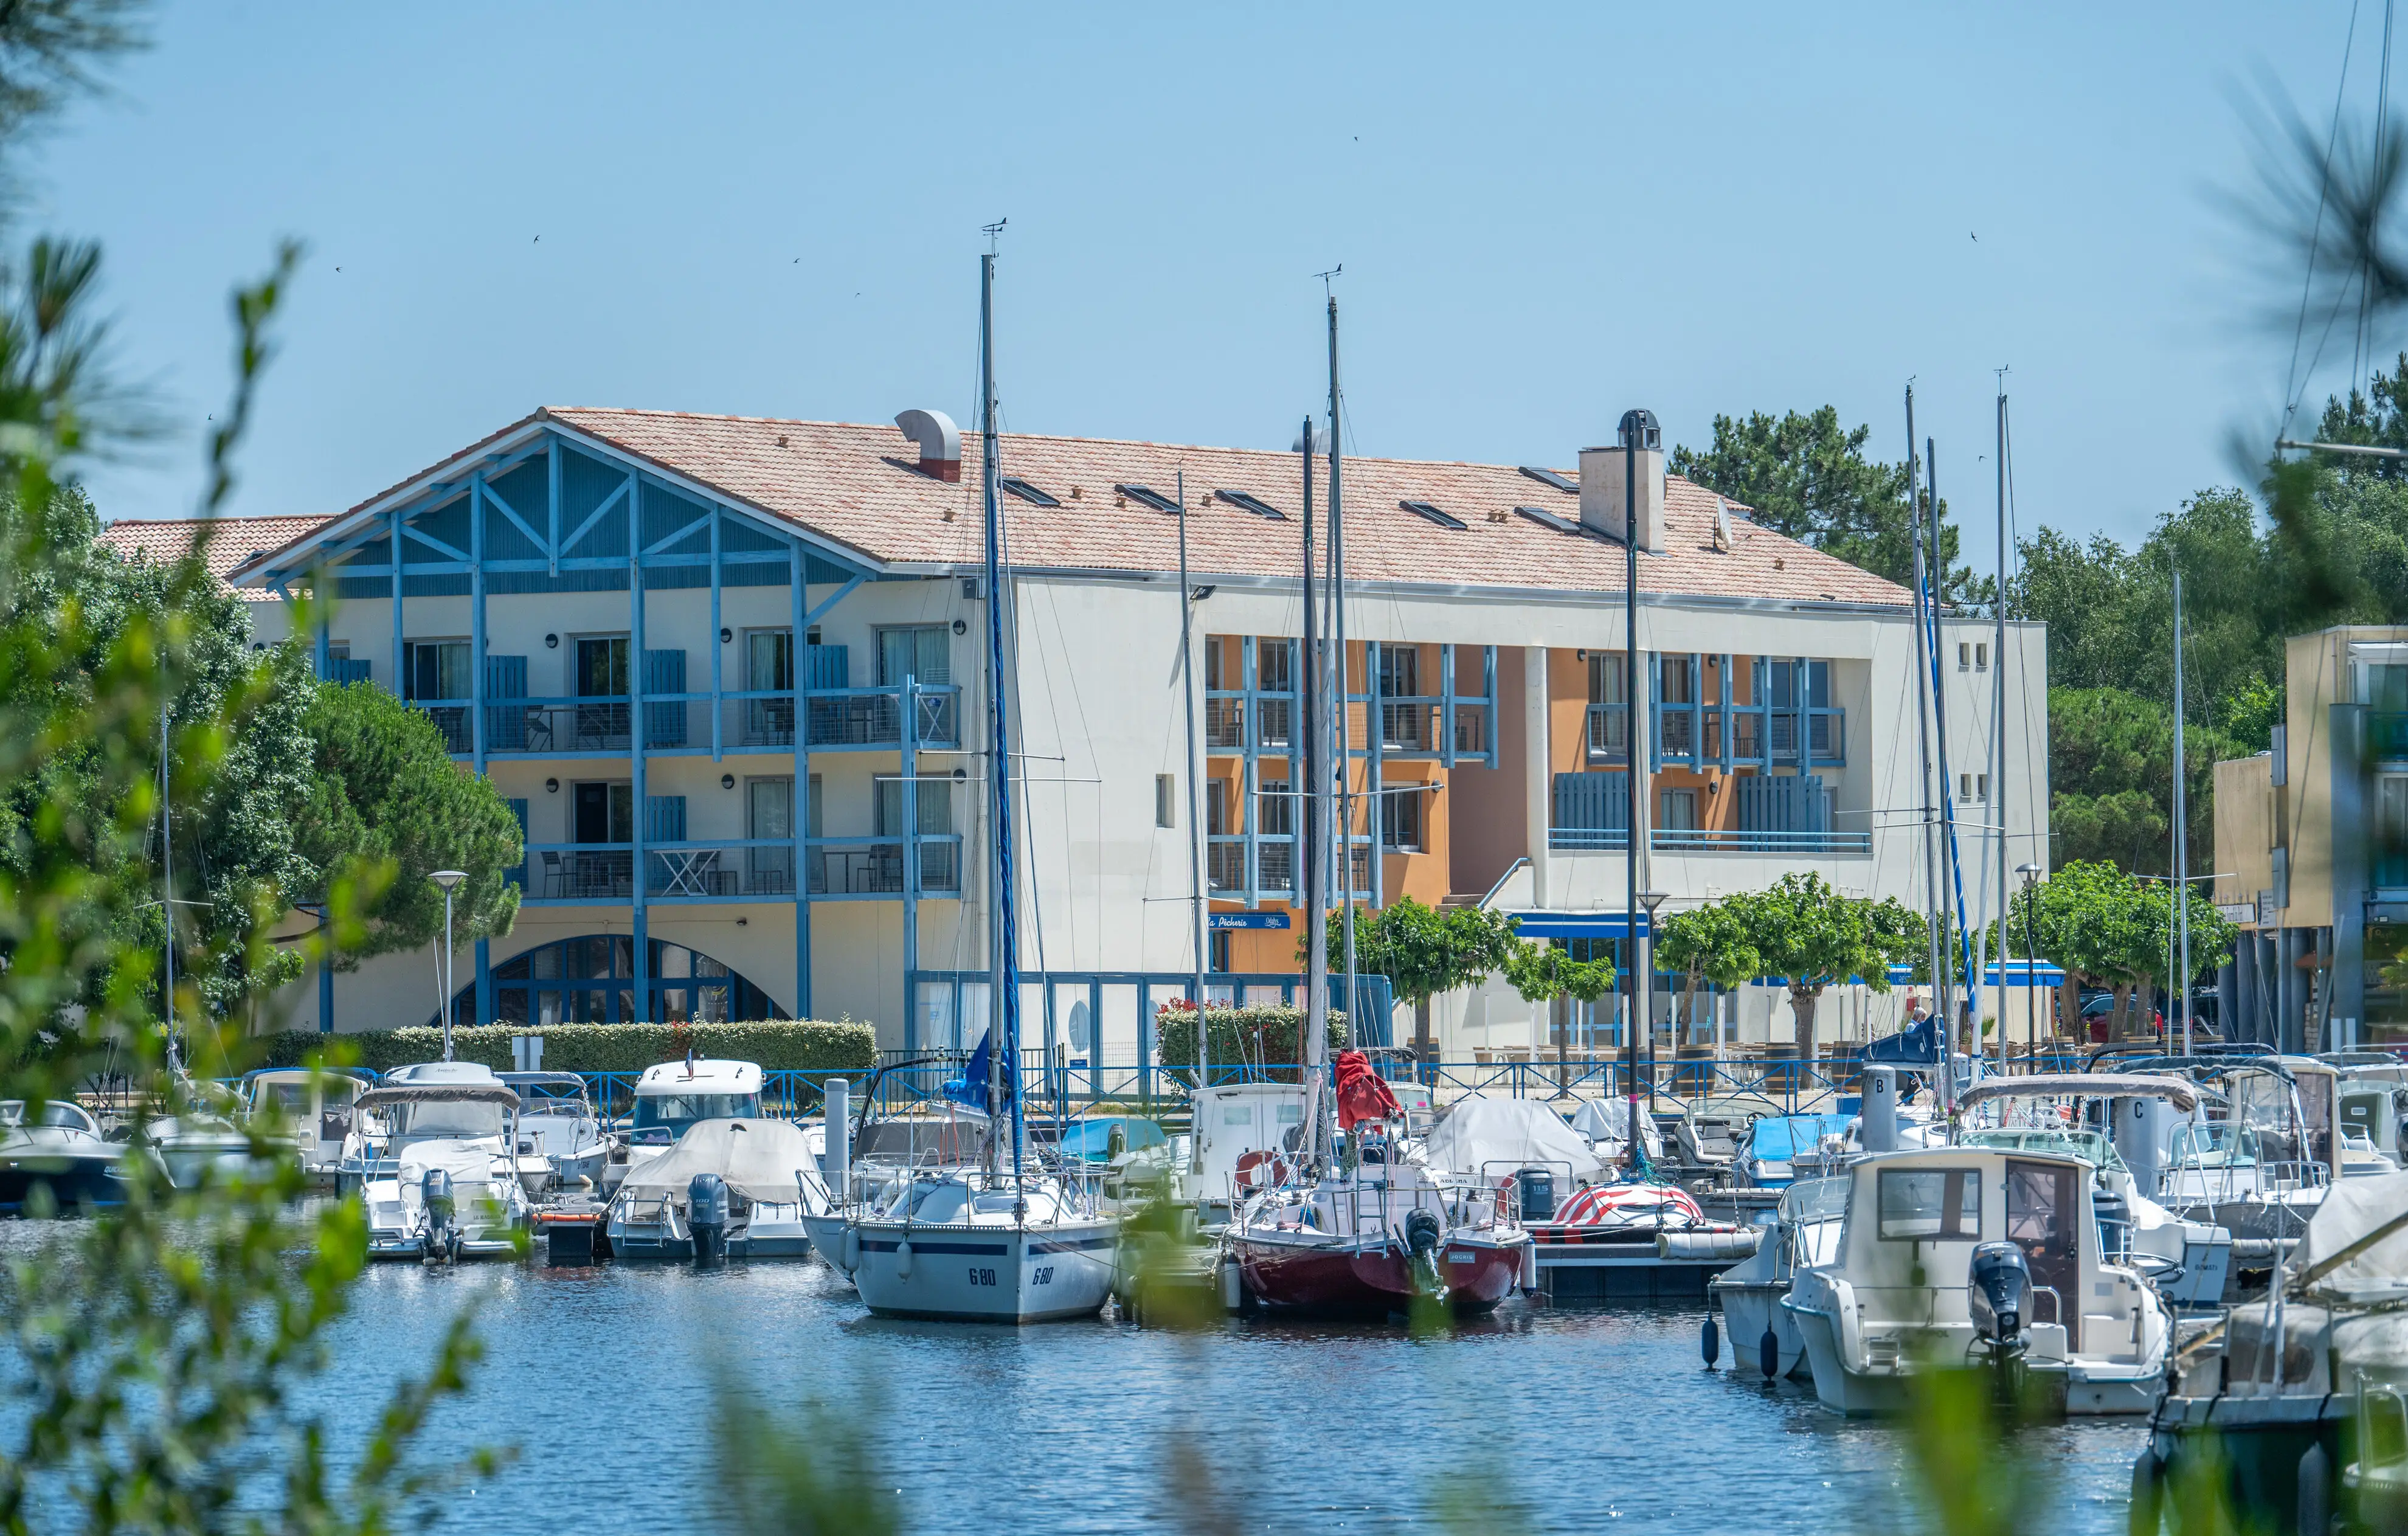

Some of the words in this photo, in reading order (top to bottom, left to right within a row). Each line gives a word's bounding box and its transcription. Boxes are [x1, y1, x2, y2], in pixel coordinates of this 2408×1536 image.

[1218, 916, 1247, 927] Pêcherie
[1877, 1079, 1884, 1093] B
[2134, 1101, 2143, 1119] C
